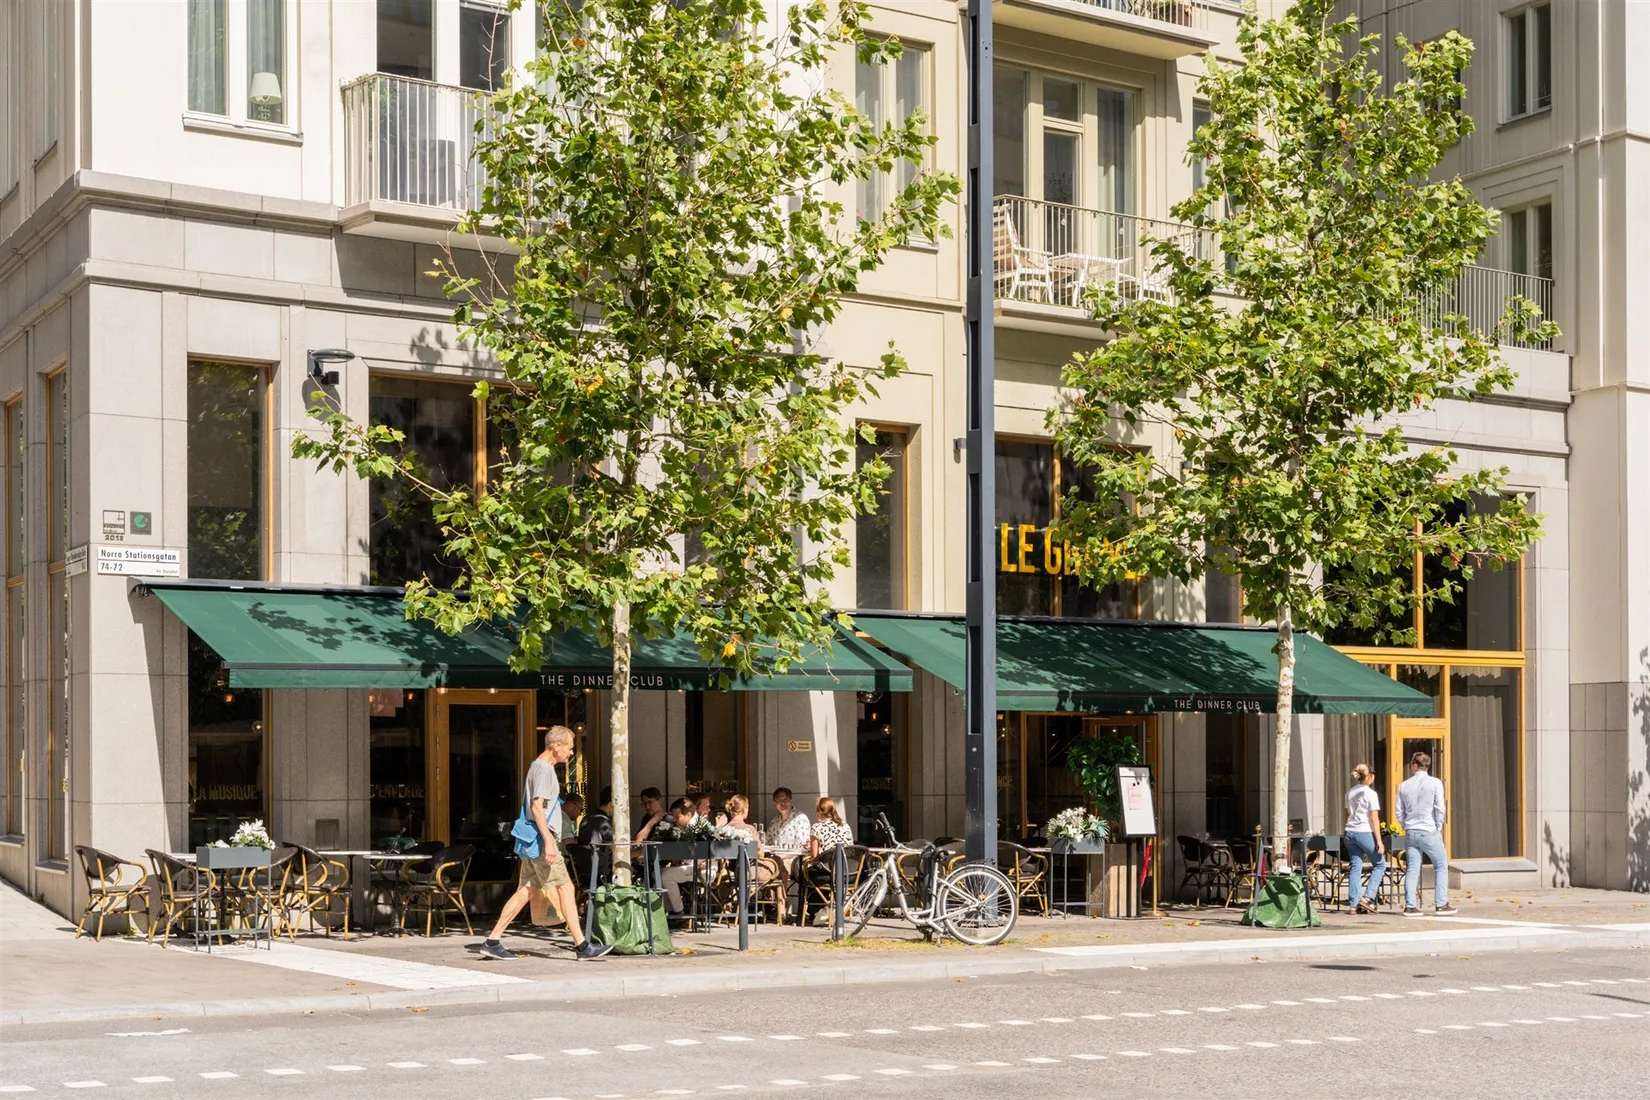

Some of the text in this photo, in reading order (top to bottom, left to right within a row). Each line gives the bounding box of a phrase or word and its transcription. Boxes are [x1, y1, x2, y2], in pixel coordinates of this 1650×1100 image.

[1001, 523, 1036, 573] LE
[101, 549, 177, 562] Norra Stationsgatan
[100, 562, 123, 571] 74-72
[540, 674, 664, 687] THE DINNE CLUB
[1174, 699, 1261, 711] THE DINNER CLUB
[208, 784, 258, 800] MUSIQUE
